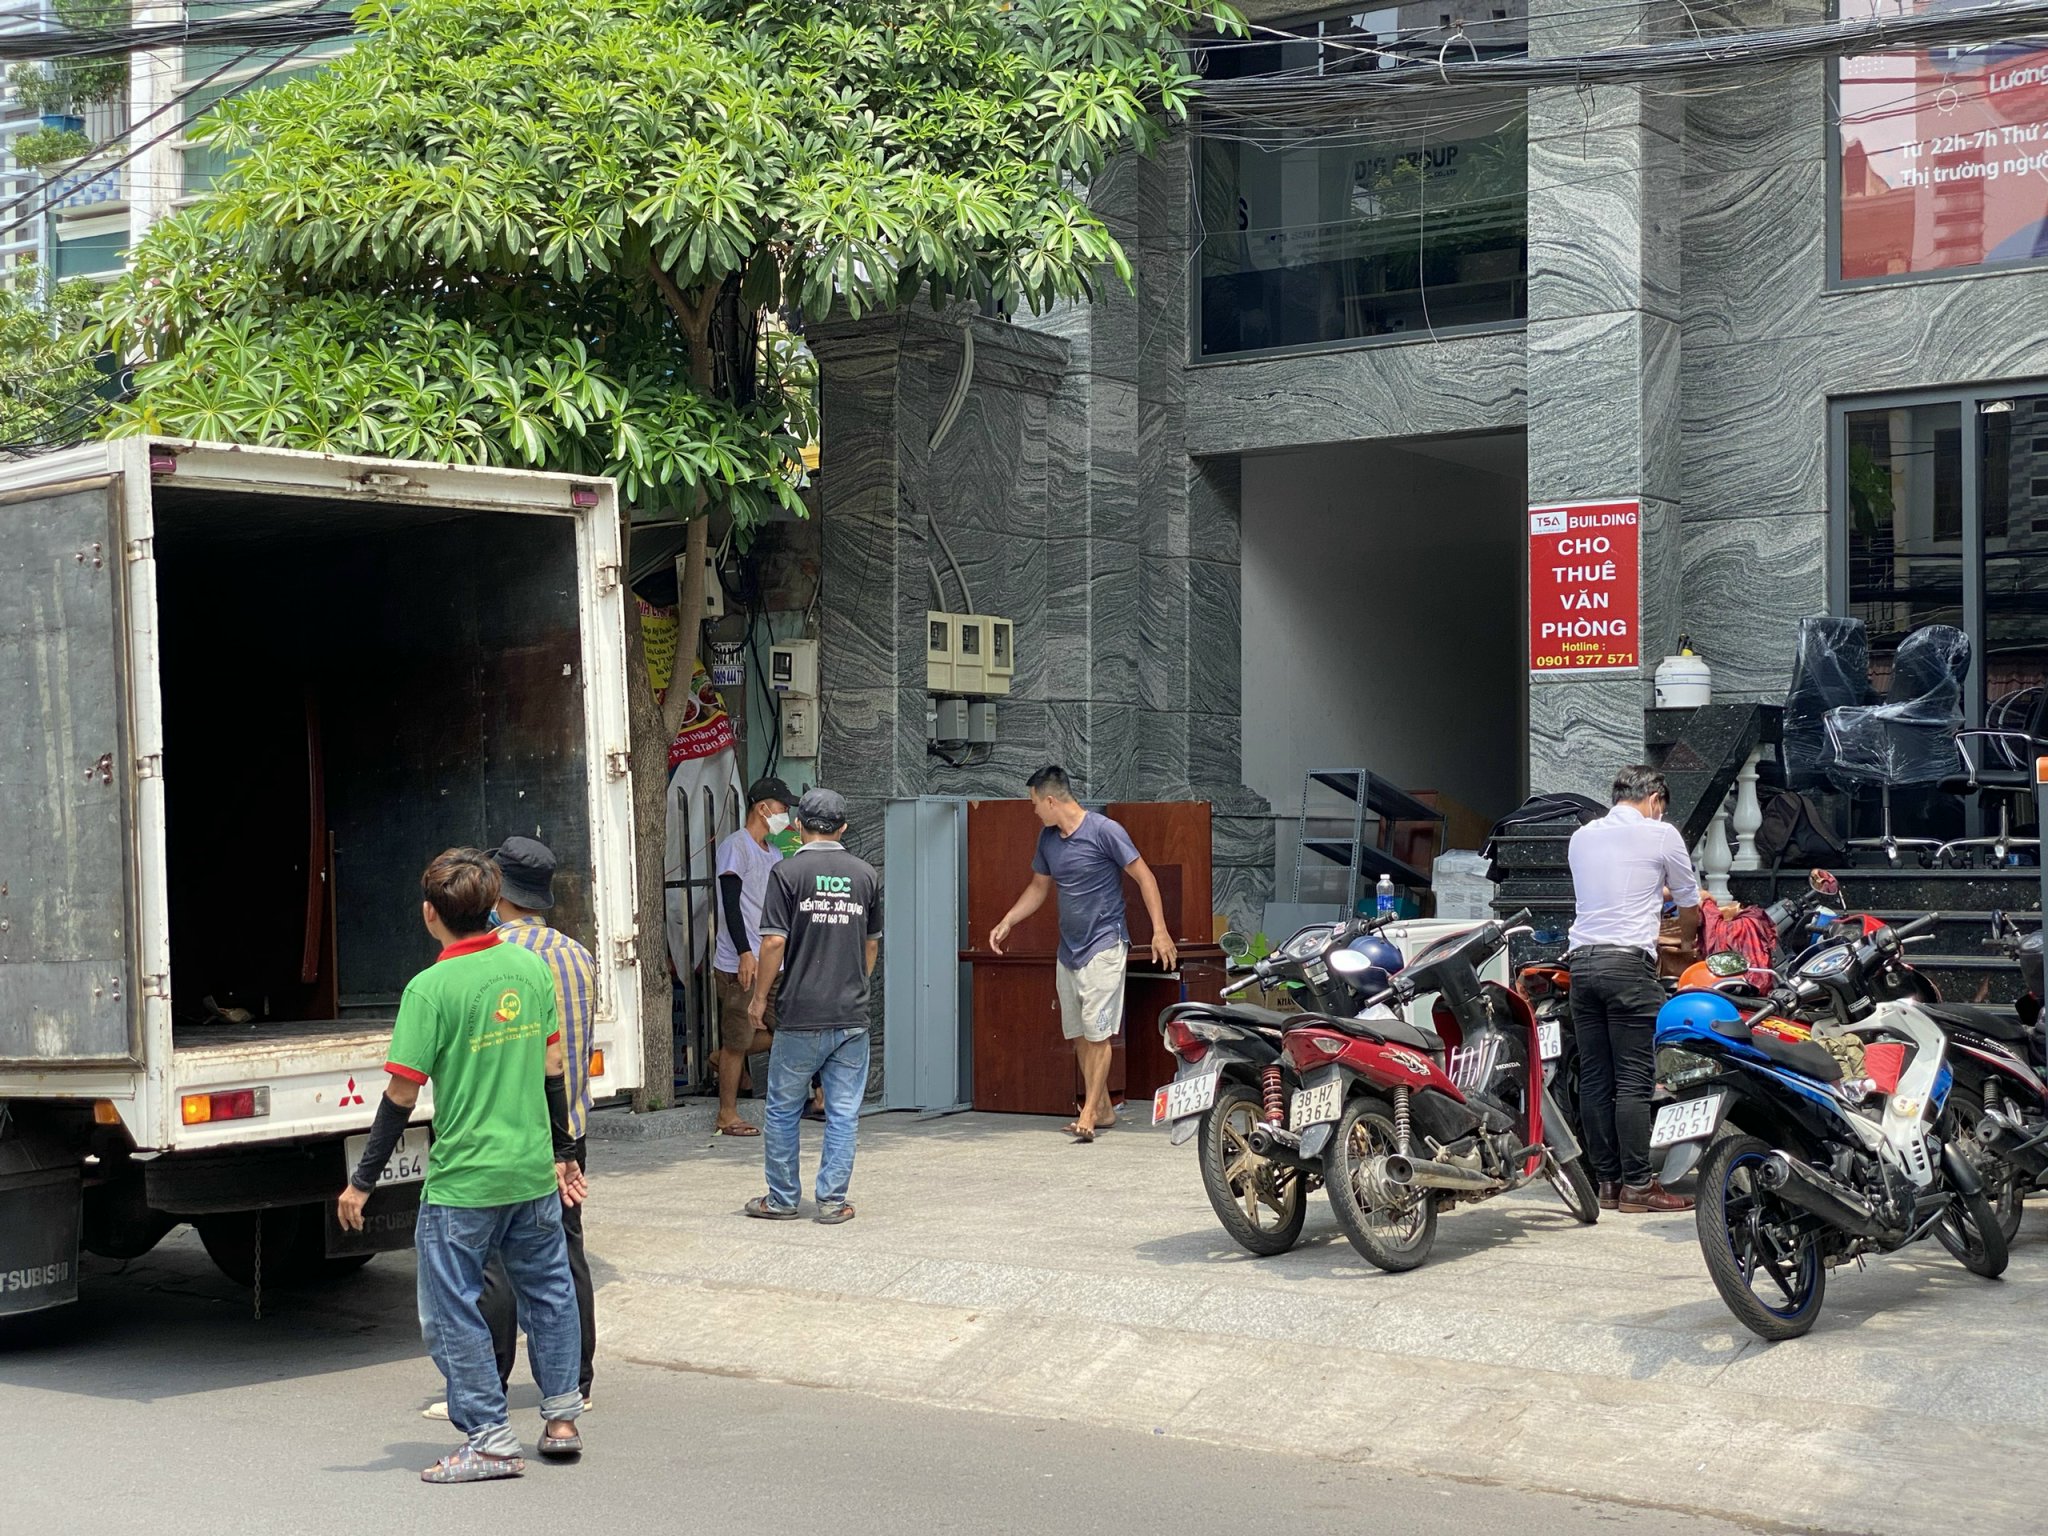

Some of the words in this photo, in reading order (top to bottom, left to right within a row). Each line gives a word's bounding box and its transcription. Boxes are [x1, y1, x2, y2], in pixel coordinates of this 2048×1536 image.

[1900, 140, 1924, 159] Từ
[1930, 129, 1998, 155] 22h-7h
[2000, 122, 2040, 145] Thứ
[1899, 166, 1929, 190] Thị
[1933, 161, 1999, 183] trường
[1536, 516, 1560, 527] TSA
[1569, 513, 1637, 528] BUILDING
[1558, 536, 1610, 556] CHO
[1552, 560, 1616, 583] THUÊ
[1560, 589, 1609, 610] VĂN
[1541, 617, 1627, 639] PHÒNG
[1562, 642, 1599, 652] Hotline
[1536, 655, 1570, 667] 0901
[1576, 654, 1602, 665] 377
[1607, 653, 1633, 664] 571
[1495, 1062, 1521, 1070] HONDA
[1169, 1091, 1211, 1117] 112.32
[1296, 1101, 1331, 1126] 3362
[1656, 1116, 1710, 1142] 538.51
